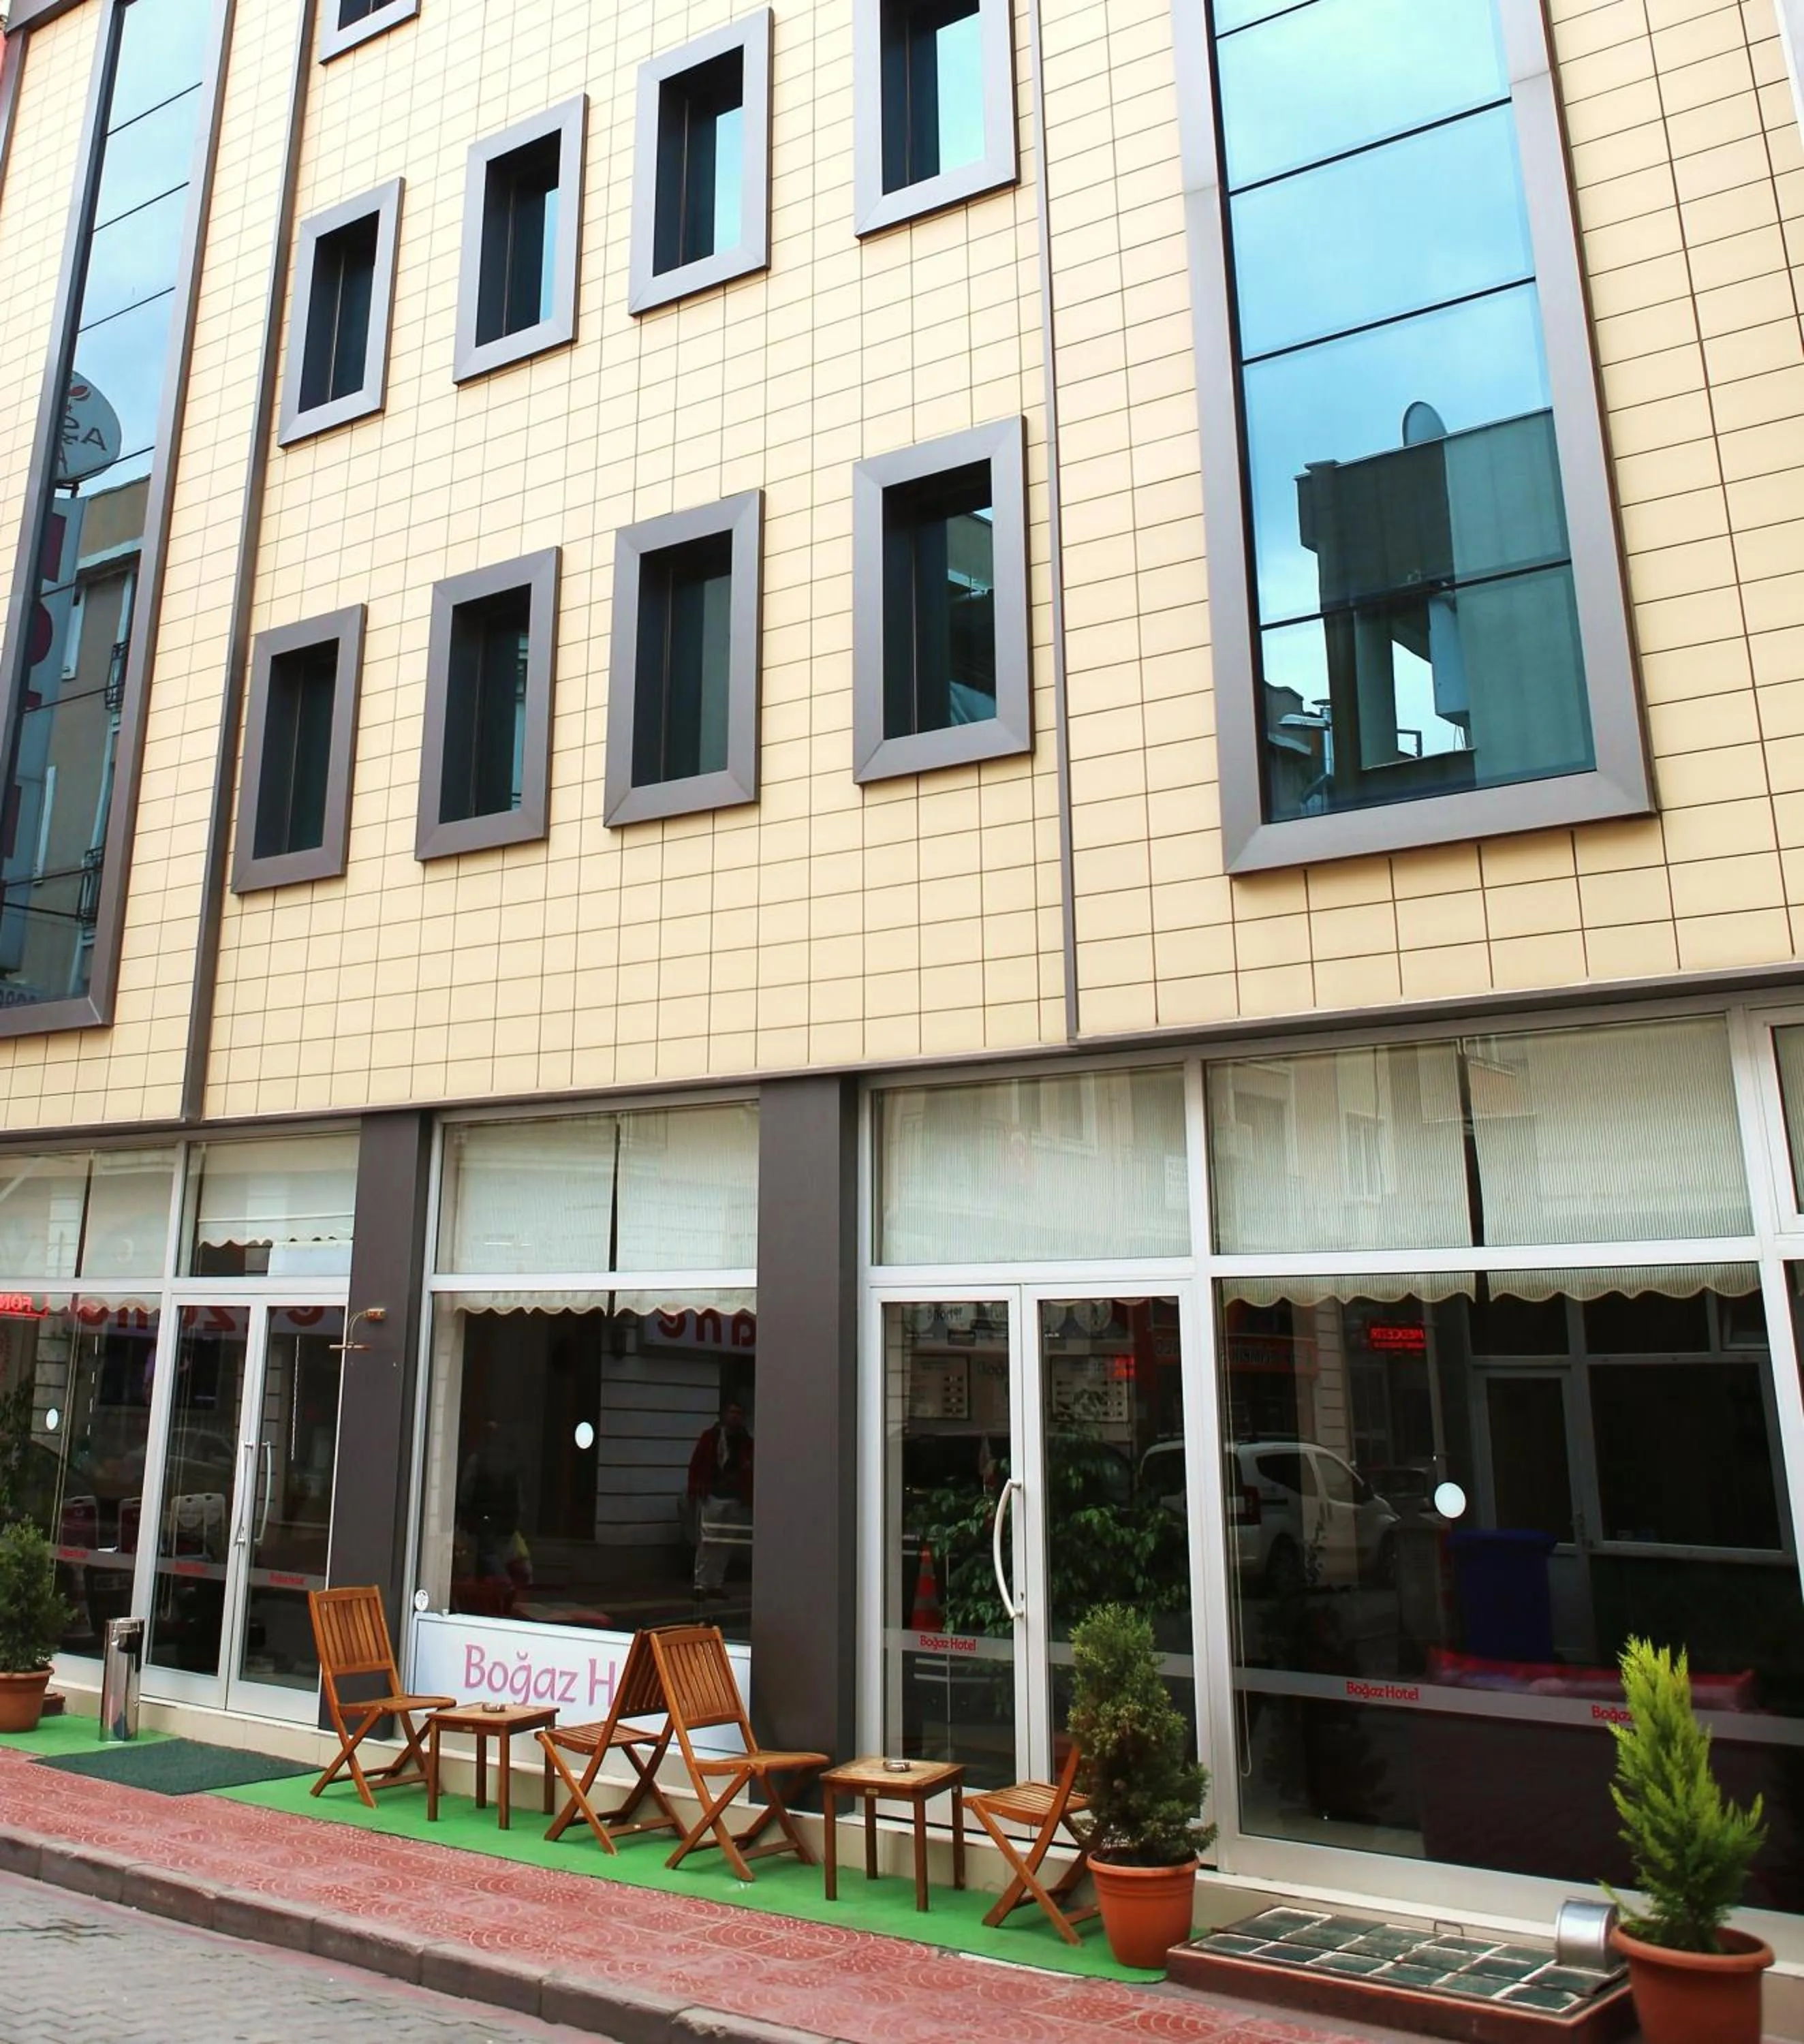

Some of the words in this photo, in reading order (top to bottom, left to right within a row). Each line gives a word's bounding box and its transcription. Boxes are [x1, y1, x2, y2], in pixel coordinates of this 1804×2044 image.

[919, 1635, 949, 1652] Boğaz
[950, 1637, 976, 1651] Hotel
[465, 1643, 578, 1706] Boğaz
[1346, 1680, 1384, 1699] Boğaz
[1385, 1685, 1419, 1701] Hotel
